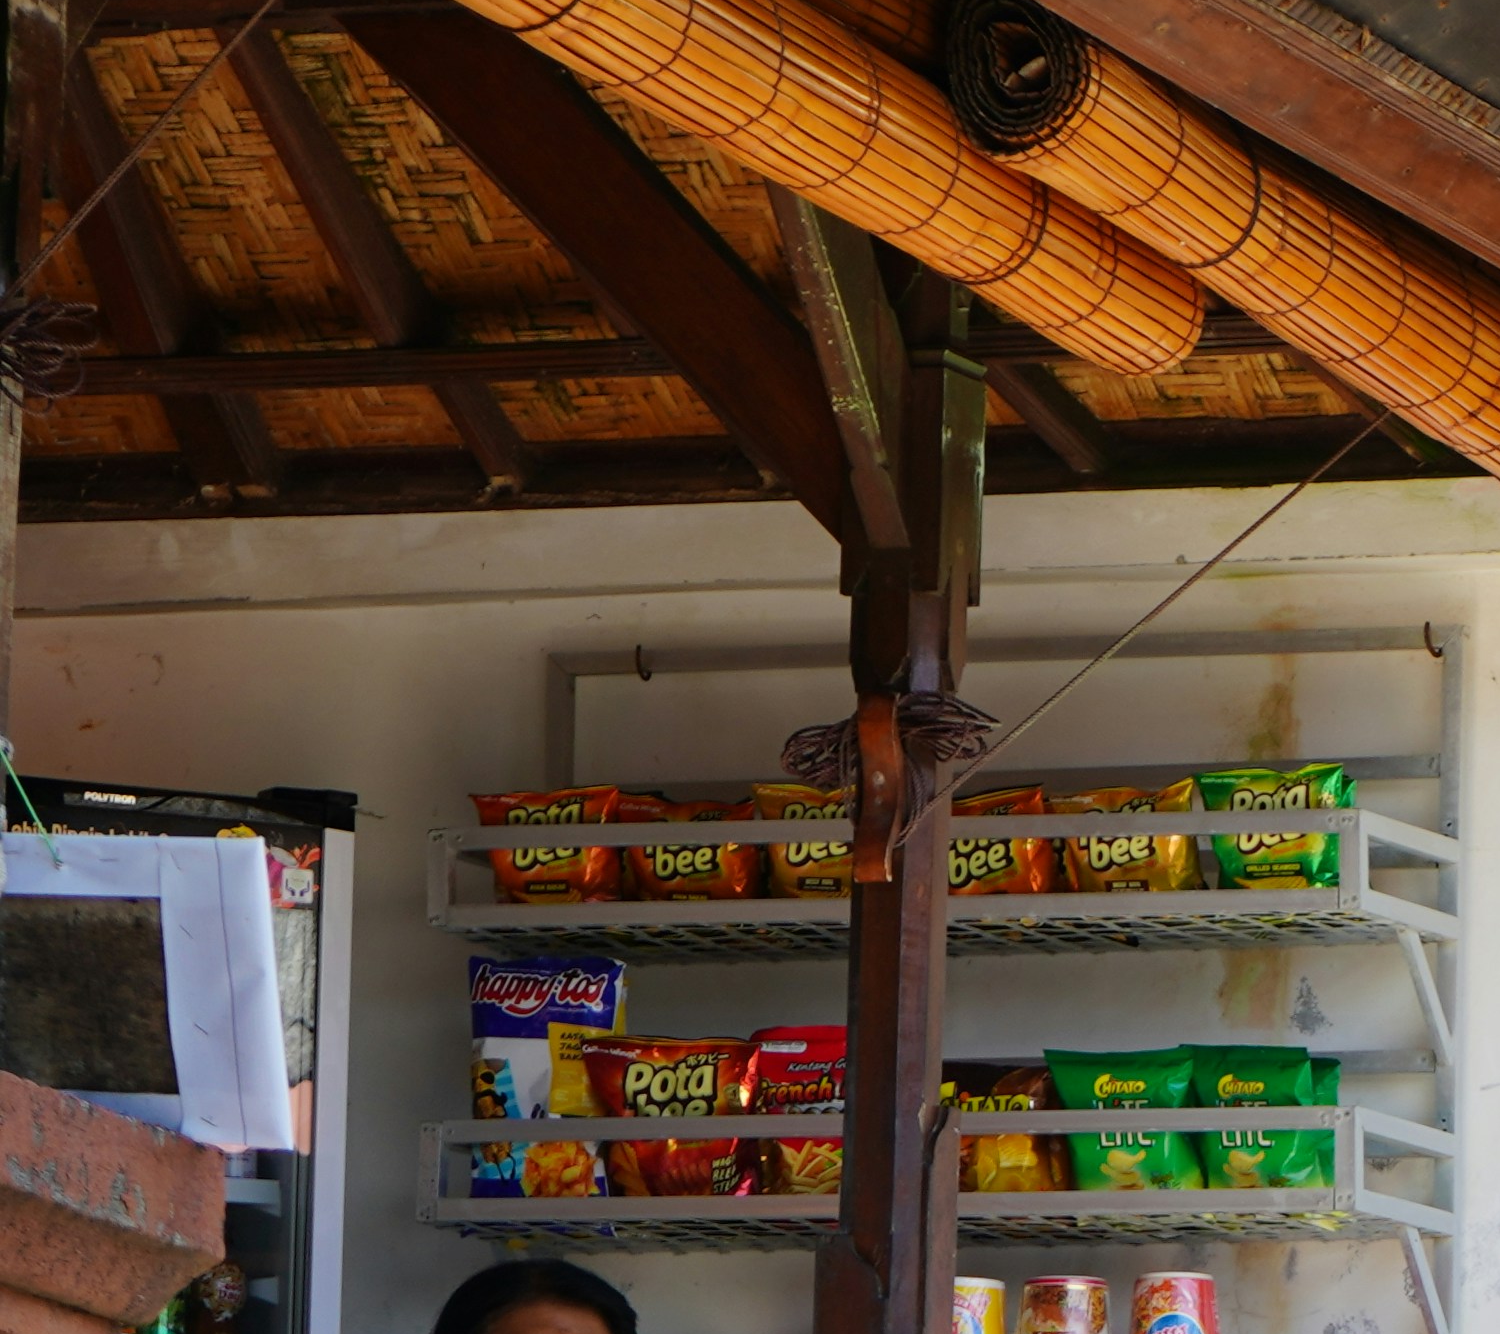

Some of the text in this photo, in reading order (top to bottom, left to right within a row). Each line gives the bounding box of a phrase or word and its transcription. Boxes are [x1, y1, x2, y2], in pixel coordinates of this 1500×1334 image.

[83, 791, 137, 806] POLYTRON
[653, 846, 715, 875] bee
[1088, 835, 1153, 870] bee
[624, 1061, 719, 1106] Pota
